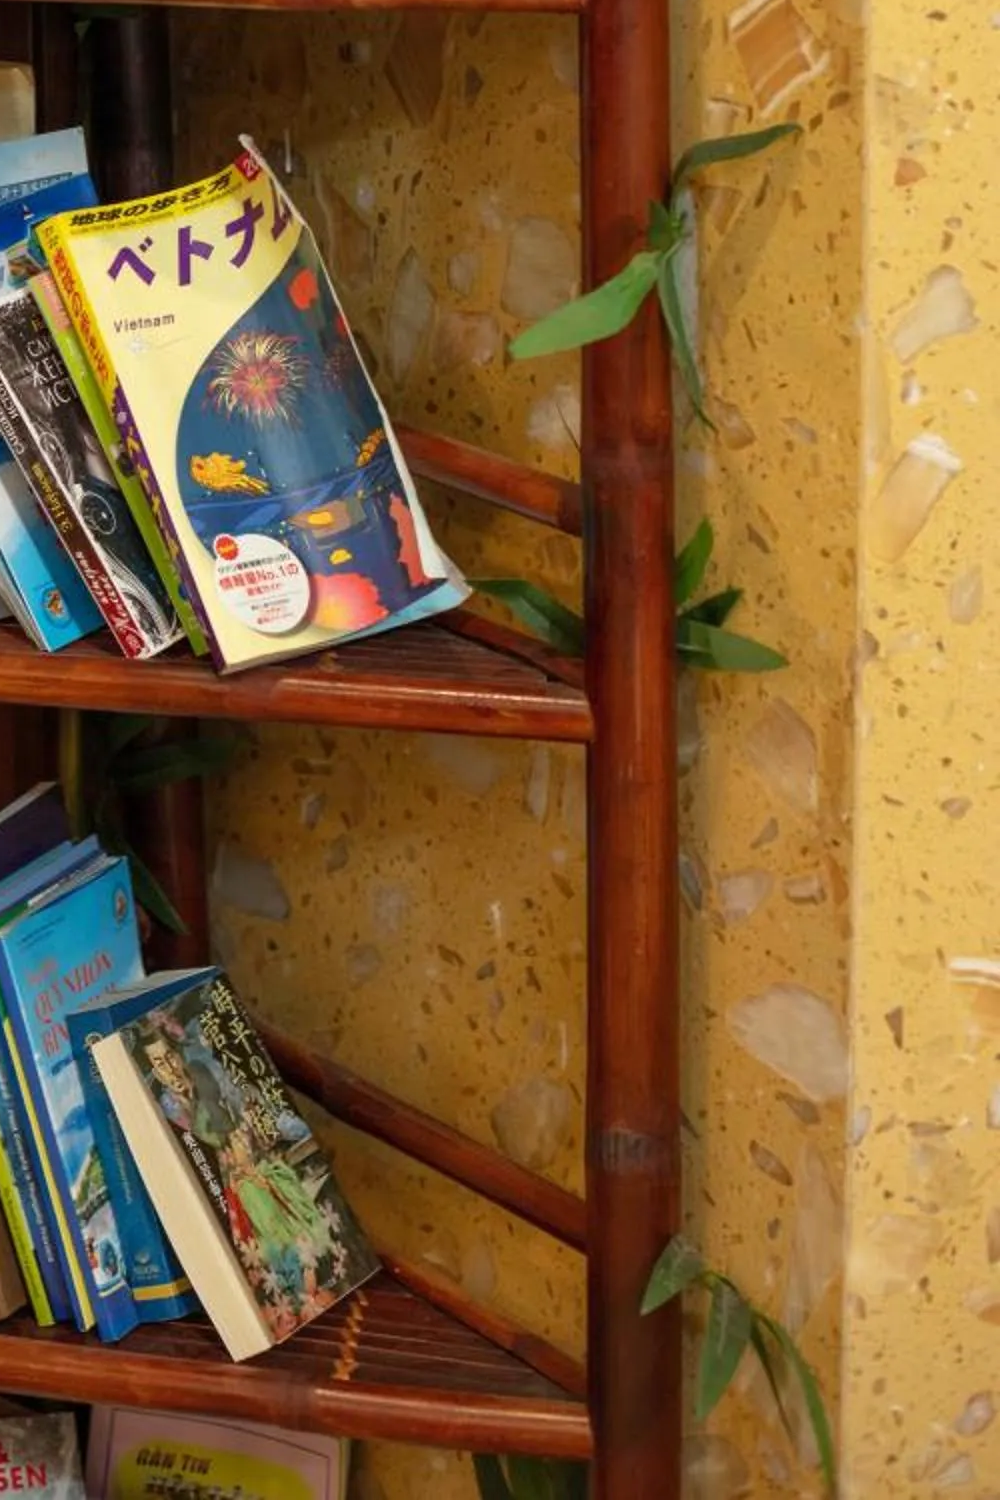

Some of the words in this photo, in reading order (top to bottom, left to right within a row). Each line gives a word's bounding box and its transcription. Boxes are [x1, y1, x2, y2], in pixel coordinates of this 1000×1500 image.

[68, 173, 235, 229] 地球の歩き方
[106, 180, 294, 288] ベトナム
[114, 311, 176, 334] Vietnam
